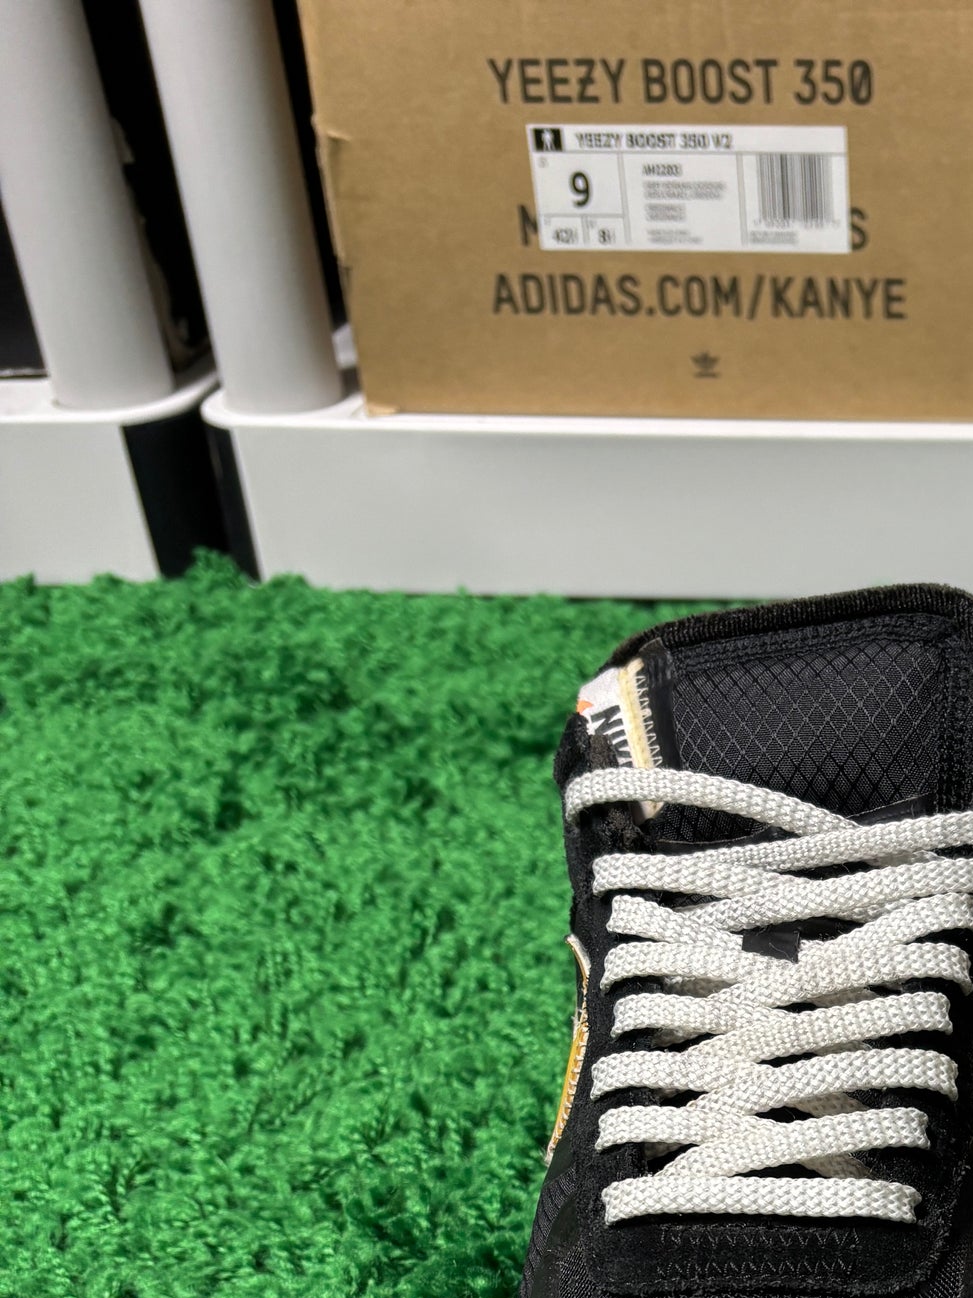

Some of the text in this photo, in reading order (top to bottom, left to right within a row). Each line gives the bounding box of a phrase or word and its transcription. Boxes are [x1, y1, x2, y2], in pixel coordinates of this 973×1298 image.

[488, 58, 874, 106] YEEZY BOOST 350
[575, 132, 620, 149] YEEZY
[626, 132, 675, 149] BOOST
[679, 132, 709, 149] 350
[569, 171, 593, 208] 9
[493, 273, 908, 322] ADIDAS.COM/KANYE
